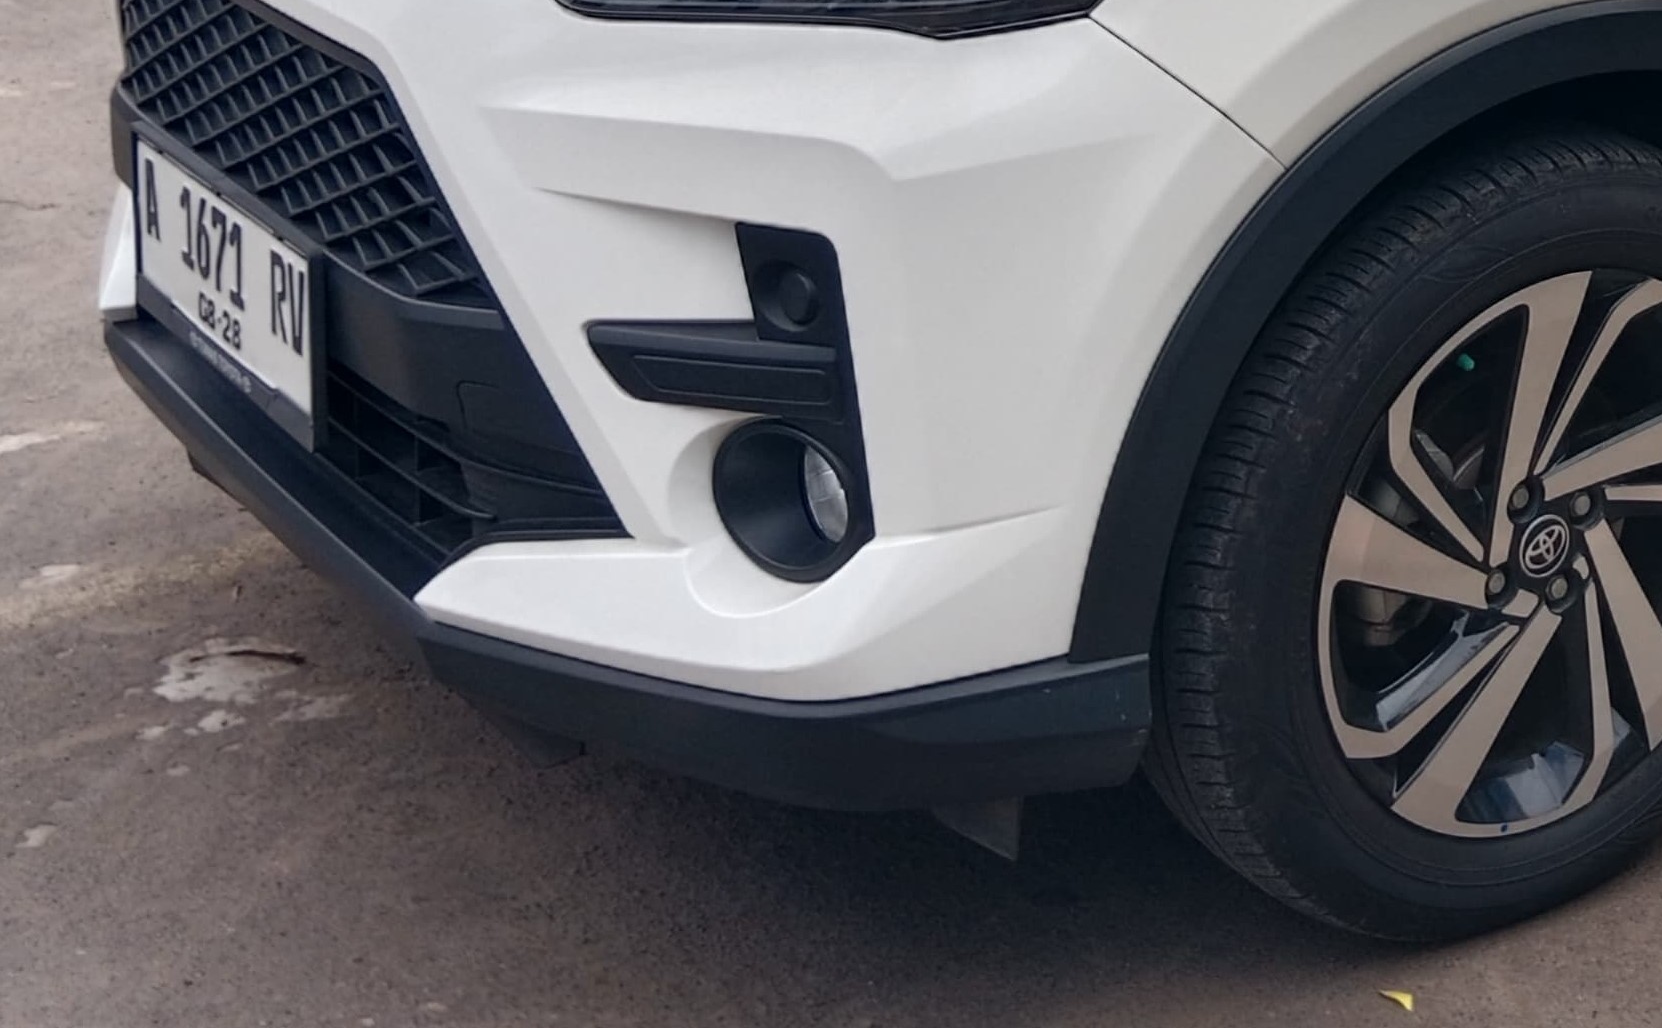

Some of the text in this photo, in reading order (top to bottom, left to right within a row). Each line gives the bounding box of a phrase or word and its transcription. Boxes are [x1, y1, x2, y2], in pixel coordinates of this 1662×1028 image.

[144, 157, 306, 357] A 1671 RV
